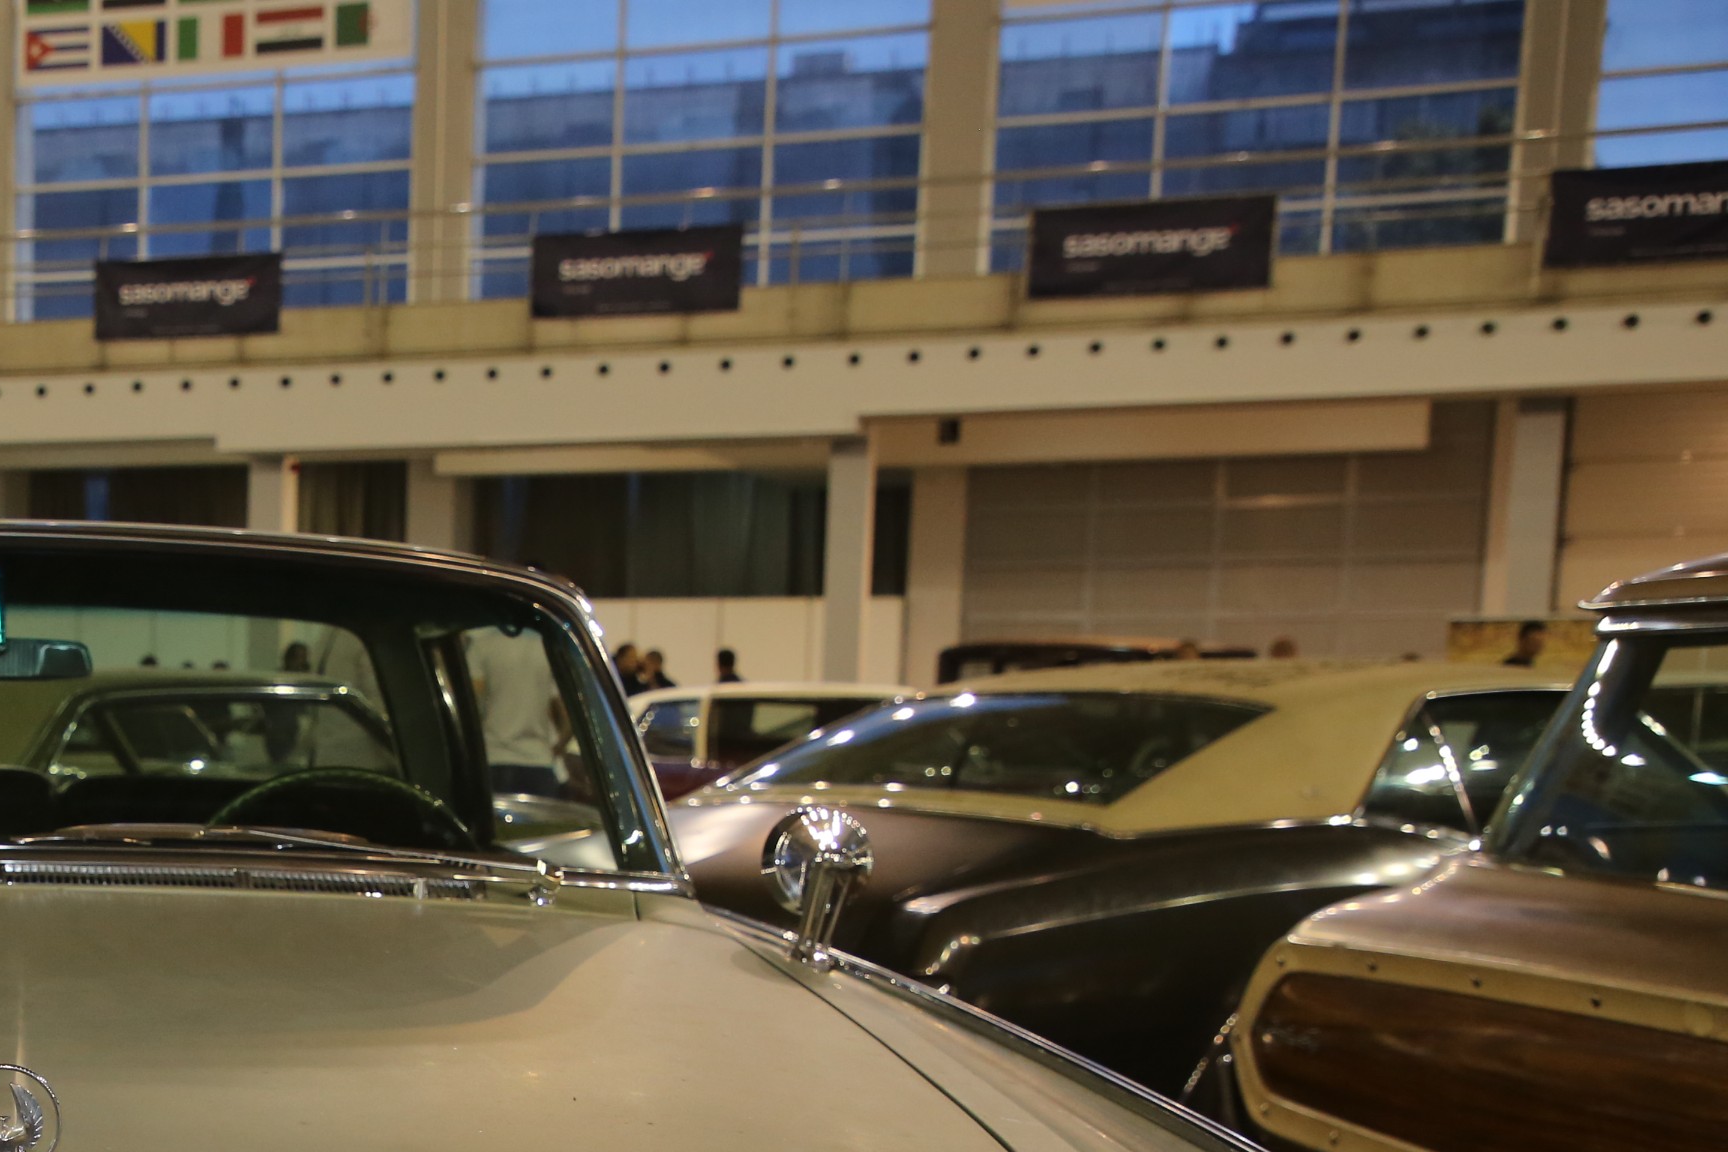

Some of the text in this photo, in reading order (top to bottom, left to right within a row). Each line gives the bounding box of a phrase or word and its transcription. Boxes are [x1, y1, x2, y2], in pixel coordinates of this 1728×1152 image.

[1062, 222, 1240, 258] sasomange
[558, 251, 714, 283] sasomange
[118, 277, 254, 306] sasomange
